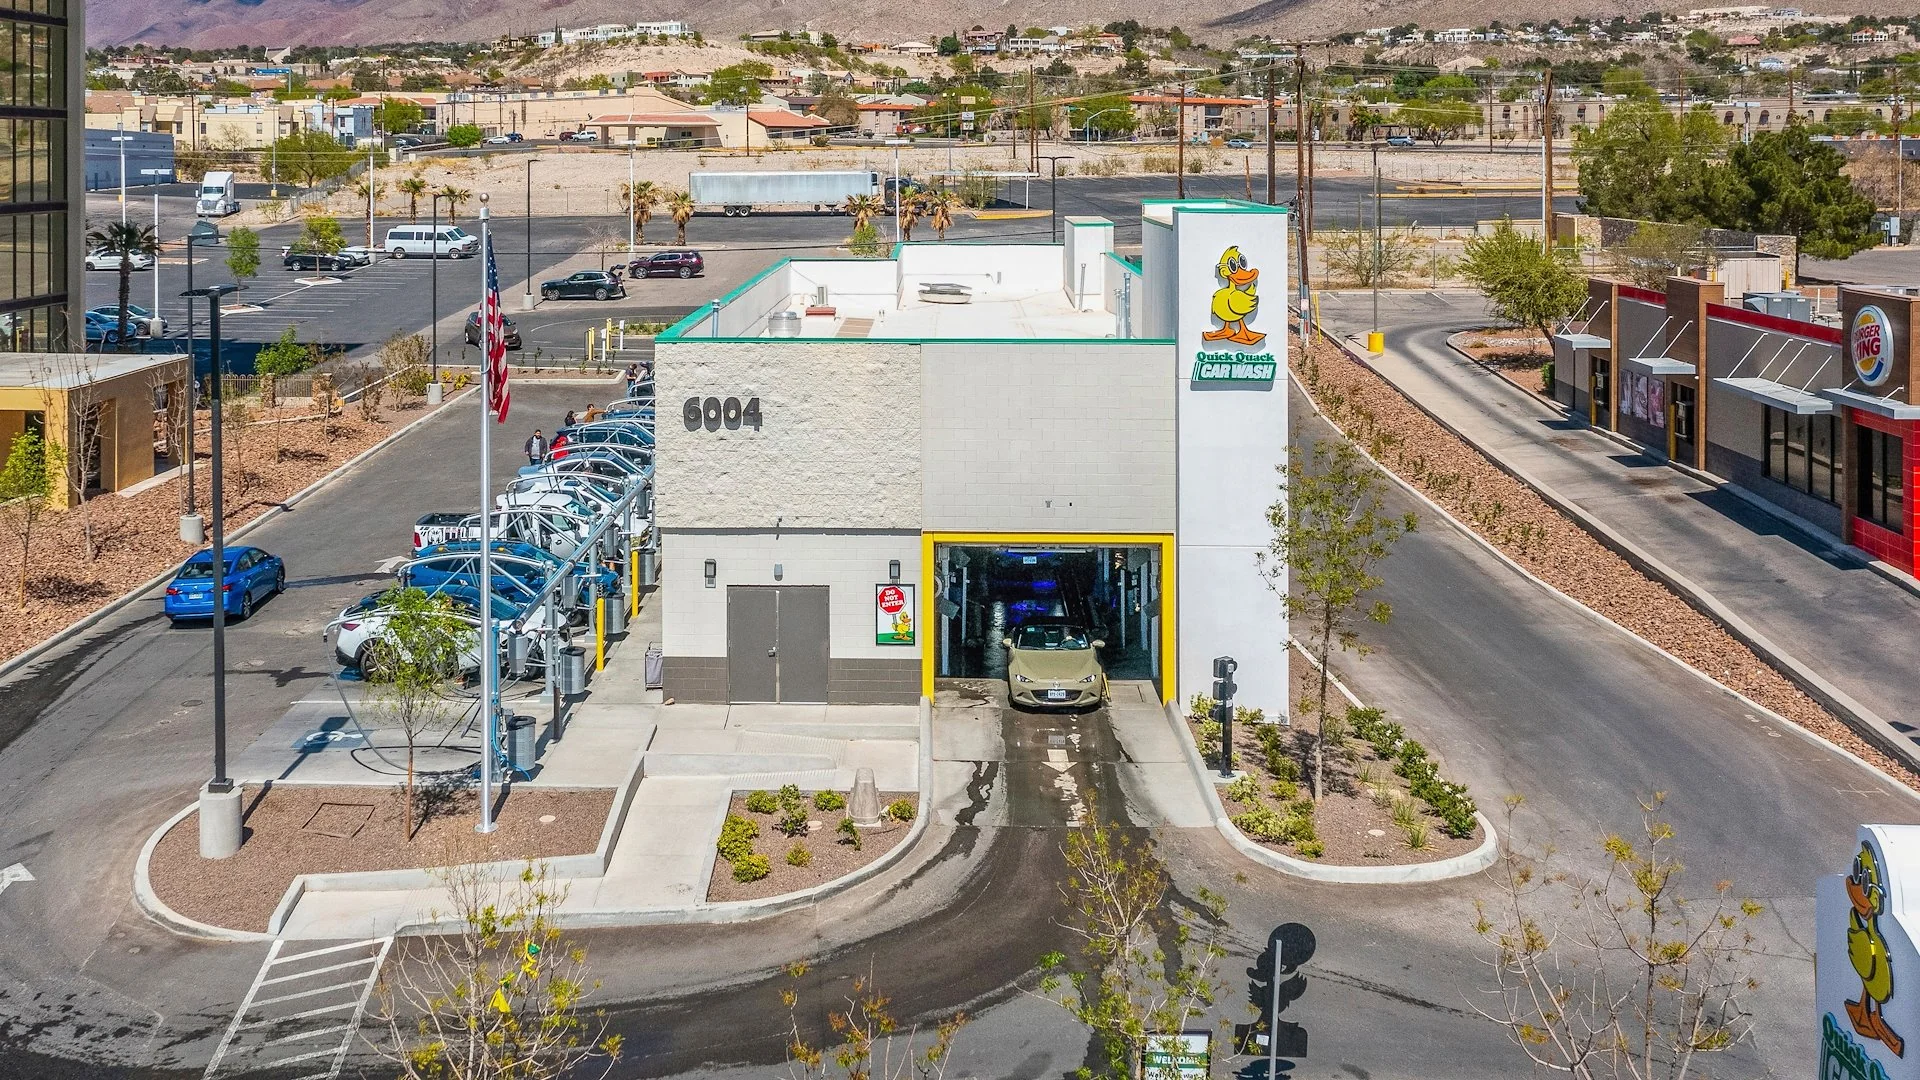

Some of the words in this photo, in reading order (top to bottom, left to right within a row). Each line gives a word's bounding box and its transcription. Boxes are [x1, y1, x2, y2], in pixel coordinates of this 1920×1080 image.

[1196, 351, 1233, 363] Quick
[1235, 351, 1275, 363] Quack
[1200, 363, 1231, 379] CAR
[1231, 363, 1275, 379] WASH
[682, 396, 763, 432] 6004
[881, 599, 904, 608] ENTER
[884, 594, 899, 602] NOT
[1822, 1013, 1868, 1079] Quick
